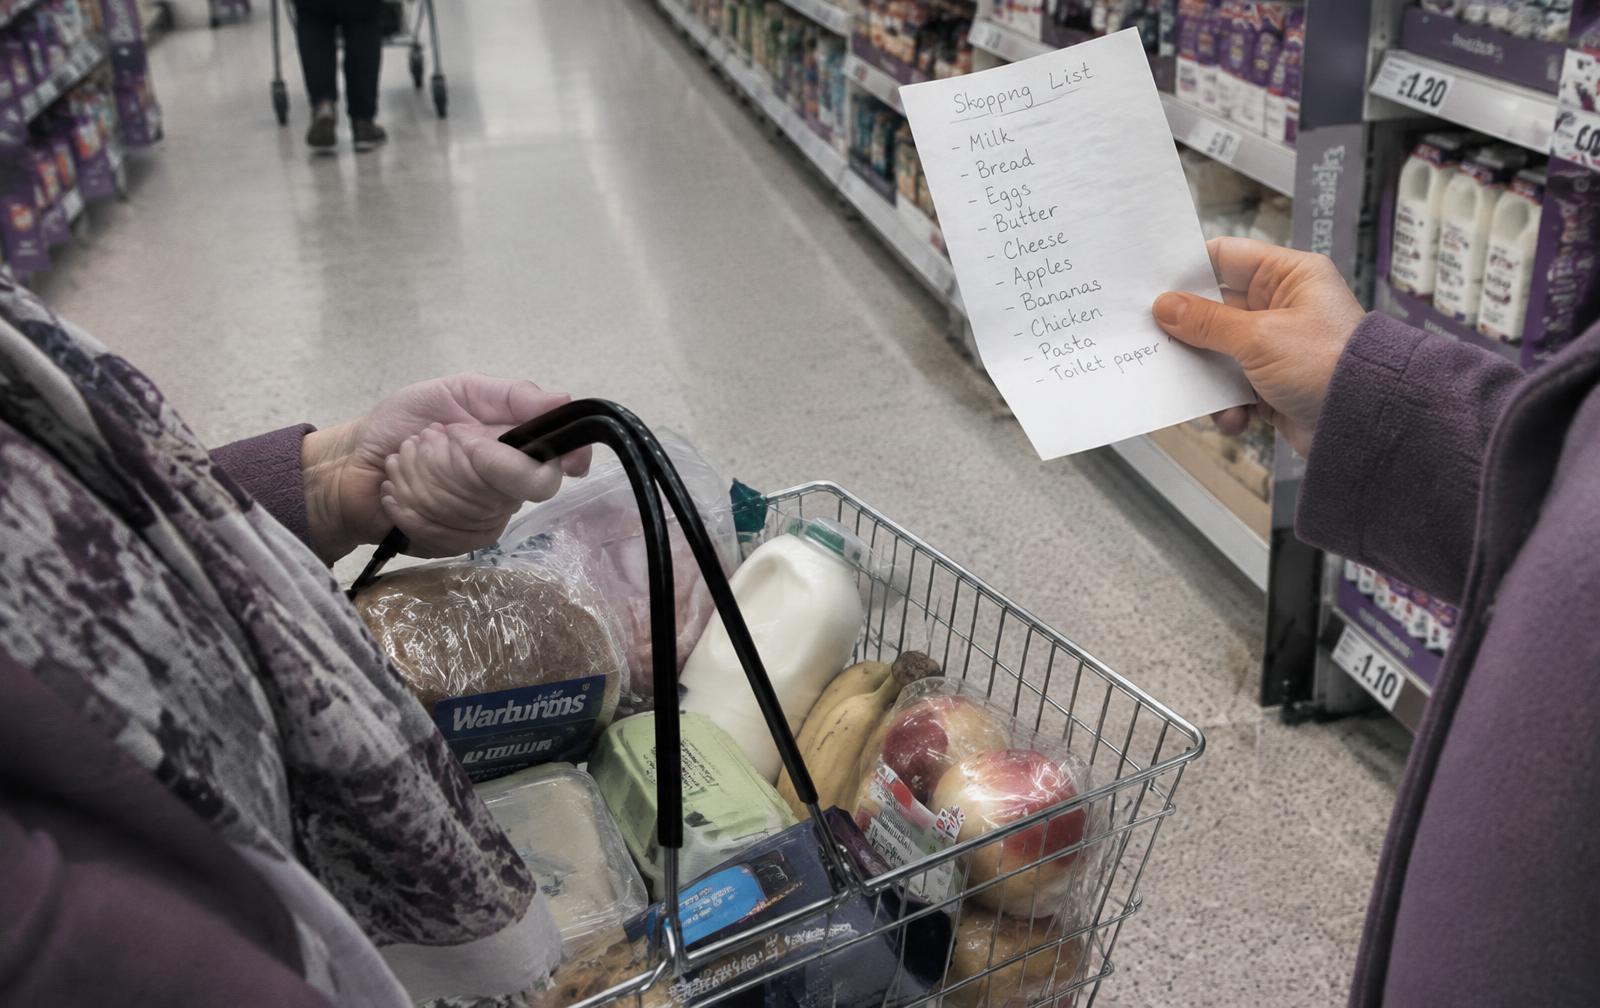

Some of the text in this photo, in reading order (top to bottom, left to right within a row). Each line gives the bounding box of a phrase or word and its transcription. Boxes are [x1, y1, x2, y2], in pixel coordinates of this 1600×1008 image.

[1048, 62, 1094, 90] List
[969, 127, 1016, 153] Milk
[975, 148, 1036, 180] Bread
[984, 184, 1033, 212] Eggs
[993, 204, 1059, 234] Butter
[1003, 231, 1069, 260] Cheese
[1013, 258, 1073, 289] Apples
[1020, 279, 1102, 311] Bananas
[1031, 307, 1104, 337] Chicken
[1038, 333, 1097, 360] Pasta
[1050, 343, 1160, 381] Toilet paper
